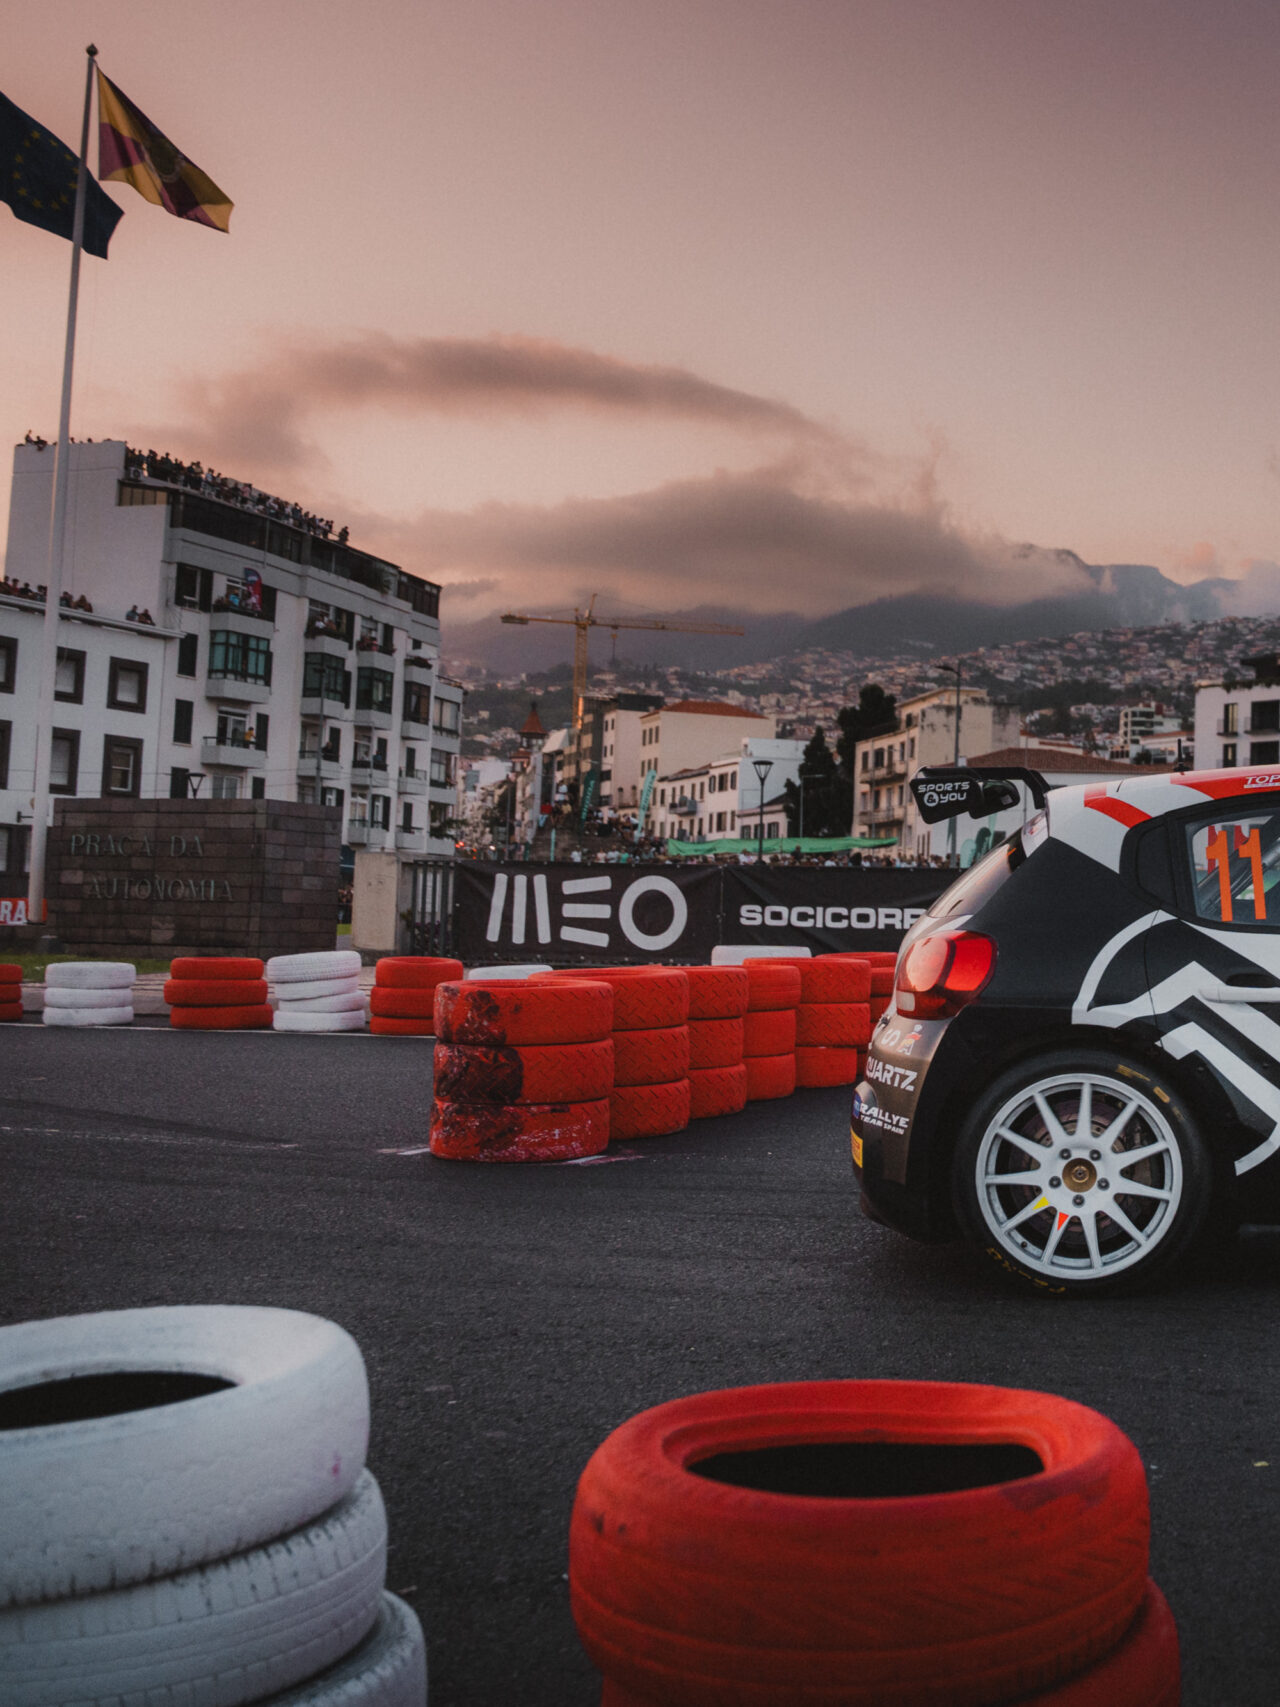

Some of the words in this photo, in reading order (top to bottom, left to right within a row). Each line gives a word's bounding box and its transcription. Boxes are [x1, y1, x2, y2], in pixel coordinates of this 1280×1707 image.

[918, 781, 970, 793] SPORTS
[939, 792, 967, 804] YOU
[169, 835, 204, 857] DA
[1205, 828, 1267, 922] 11
[486, 873, 688, 951] MEO
[860, 1103, 910, 1128] RALLYE
[860, 1114, 883, 1127] TEAM
